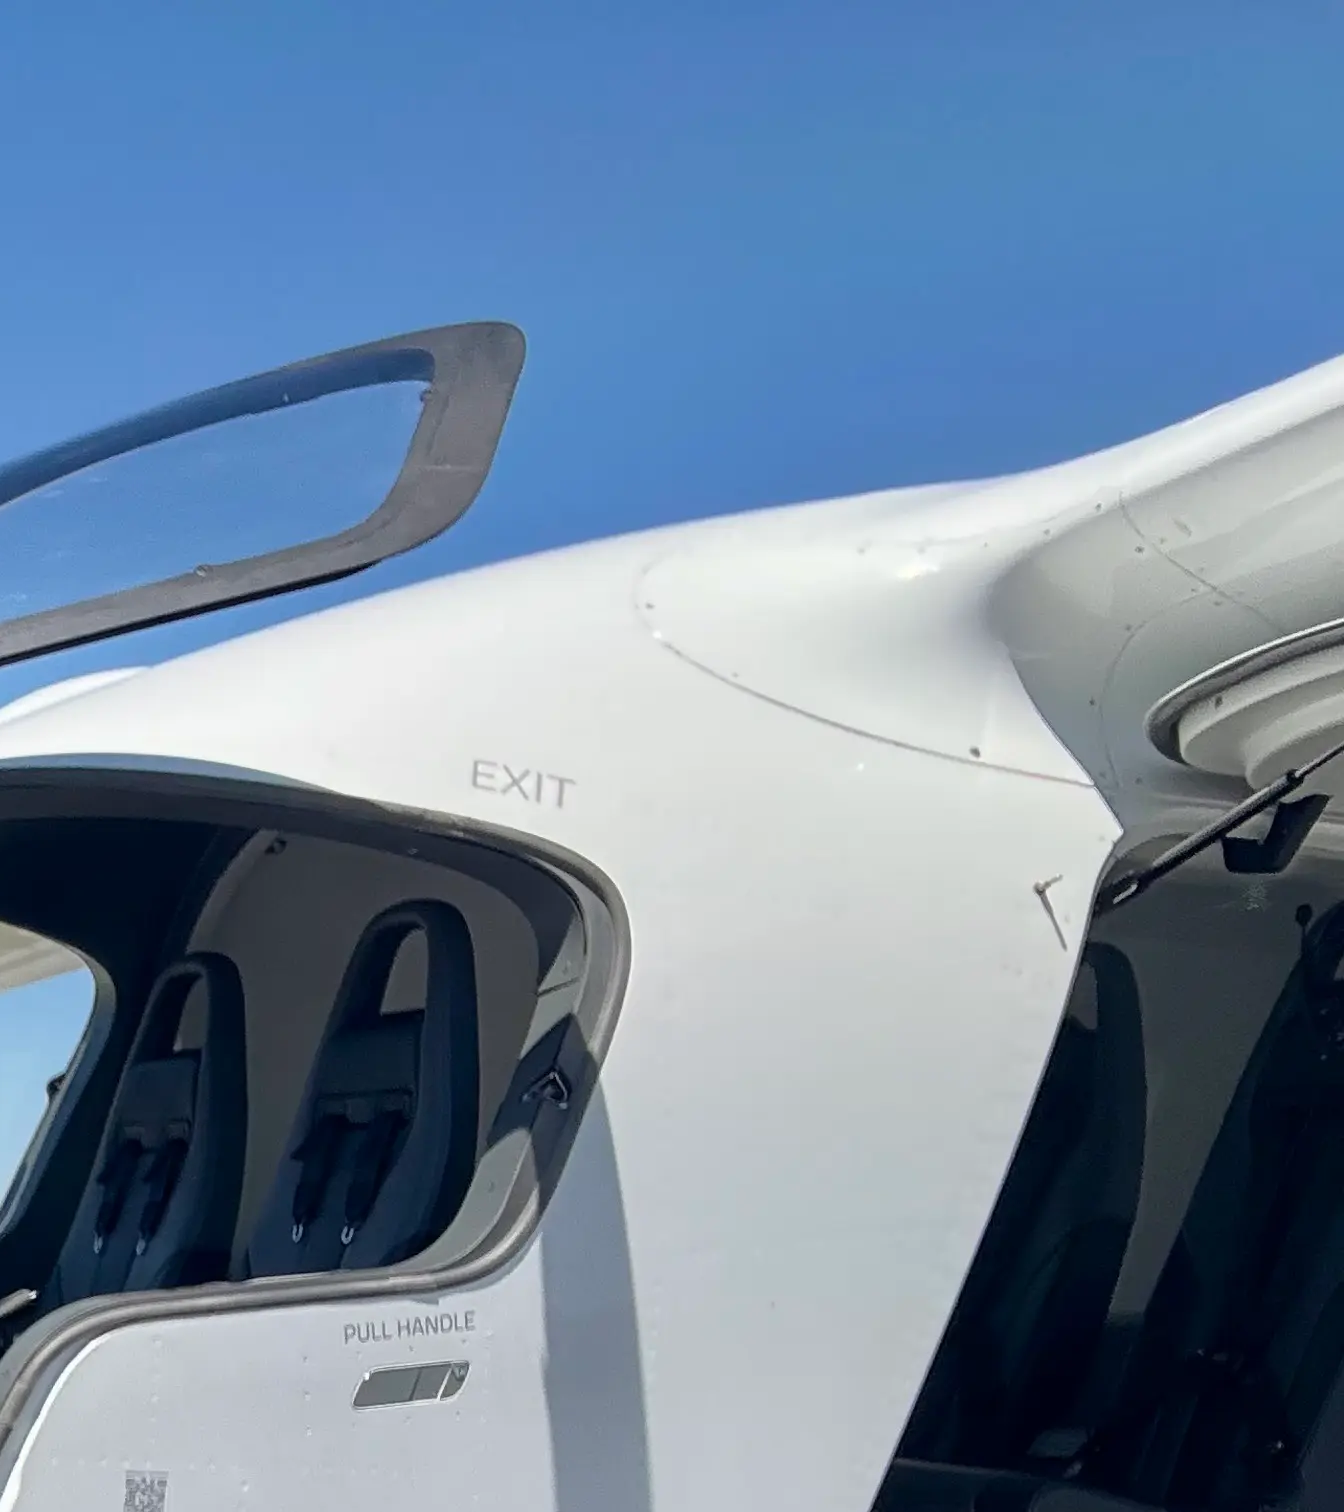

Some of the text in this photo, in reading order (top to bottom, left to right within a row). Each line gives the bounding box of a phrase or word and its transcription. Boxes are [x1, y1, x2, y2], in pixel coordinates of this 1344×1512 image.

[470, 758, 577, 810] EXIT
[343, 1309, 476, 1345] PULL HANDLE
